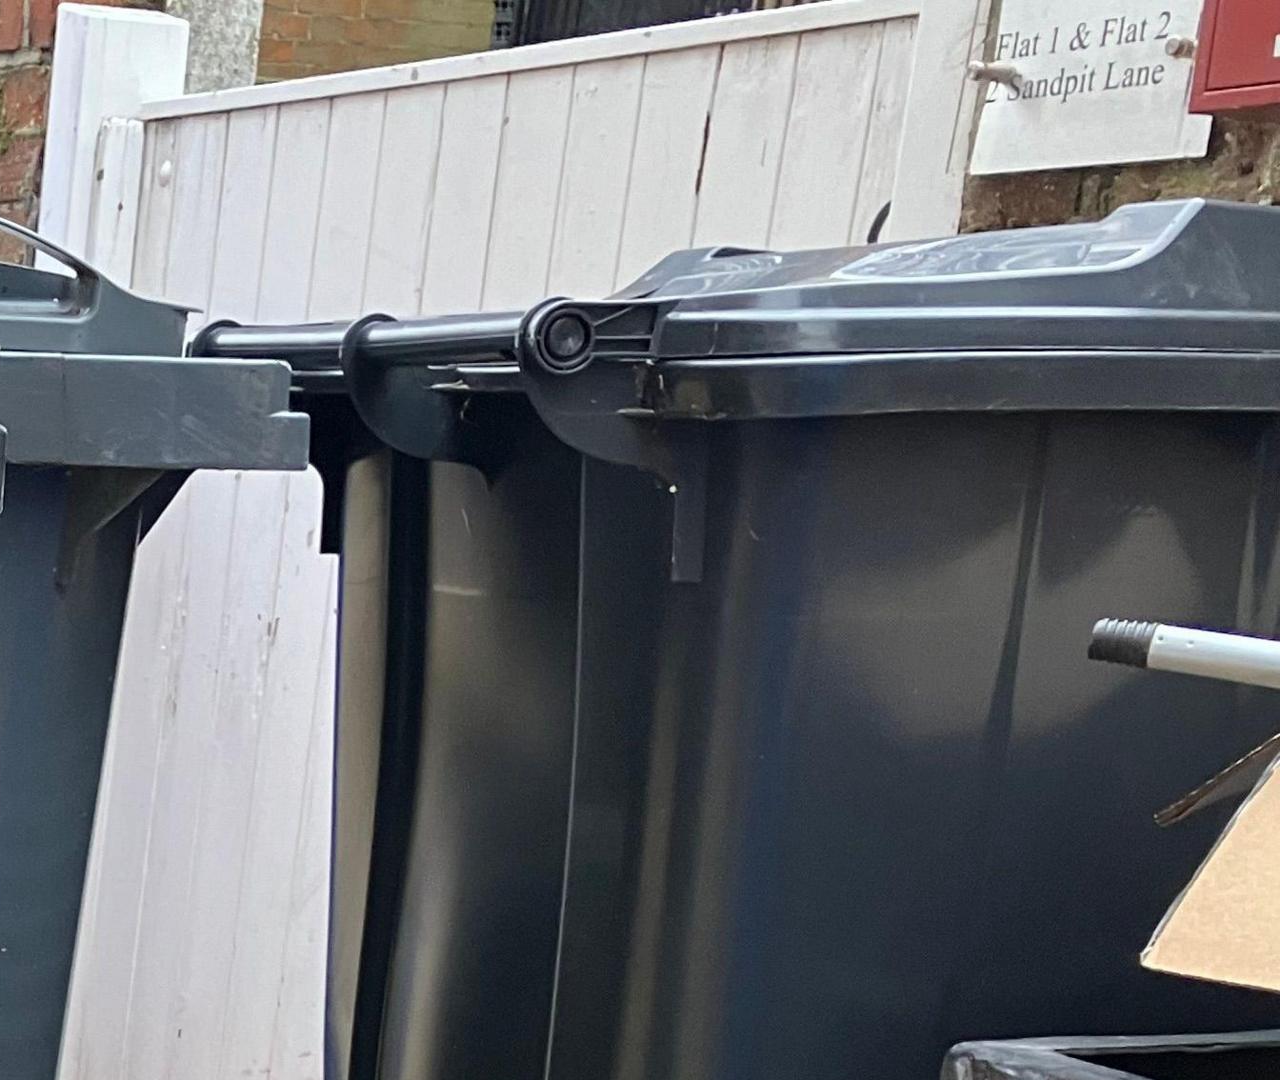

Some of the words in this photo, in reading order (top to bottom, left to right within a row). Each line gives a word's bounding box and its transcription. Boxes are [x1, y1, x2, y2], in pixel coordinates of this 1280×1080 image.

[995, 31, 1041, 61] Flat
[1049, 27, 1059, 54] 1
[1069, 22, 1091, 51] &
[1099, 16, 1148, 47] Flat
[1154, 11, 1171, 40] 2
[1006, 64, 1096, 104] Sandpit
[1103, 61, 1165, 90] Lane
